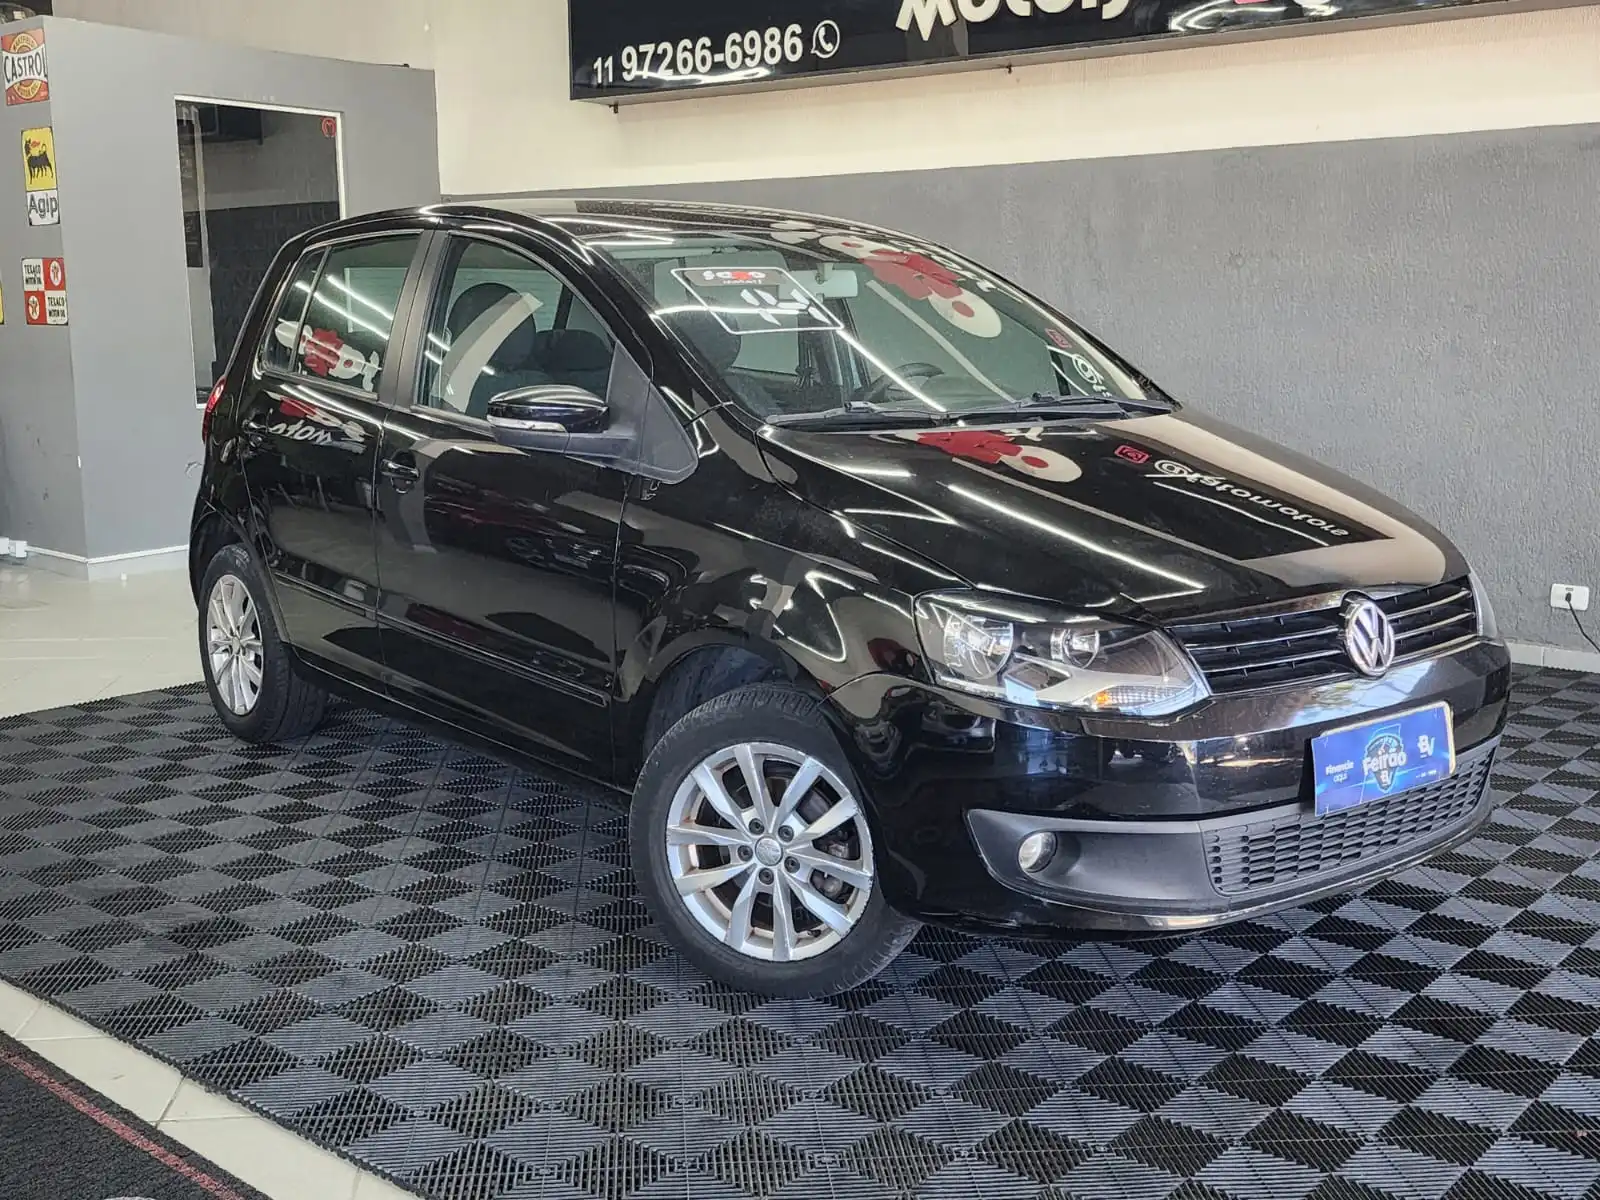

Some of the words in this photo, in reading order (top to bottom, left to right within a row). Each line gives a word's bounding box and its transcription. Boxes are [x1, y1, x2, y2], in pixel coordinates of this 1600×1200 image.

[4, 47, 48, 84] CASTROL
[593, 55, 613, 84] 11
[621, 23, 804, 82] 97266-6986
[28, 192, 58, 219] Agip
[47, 296, 65, 307] TEXACO
